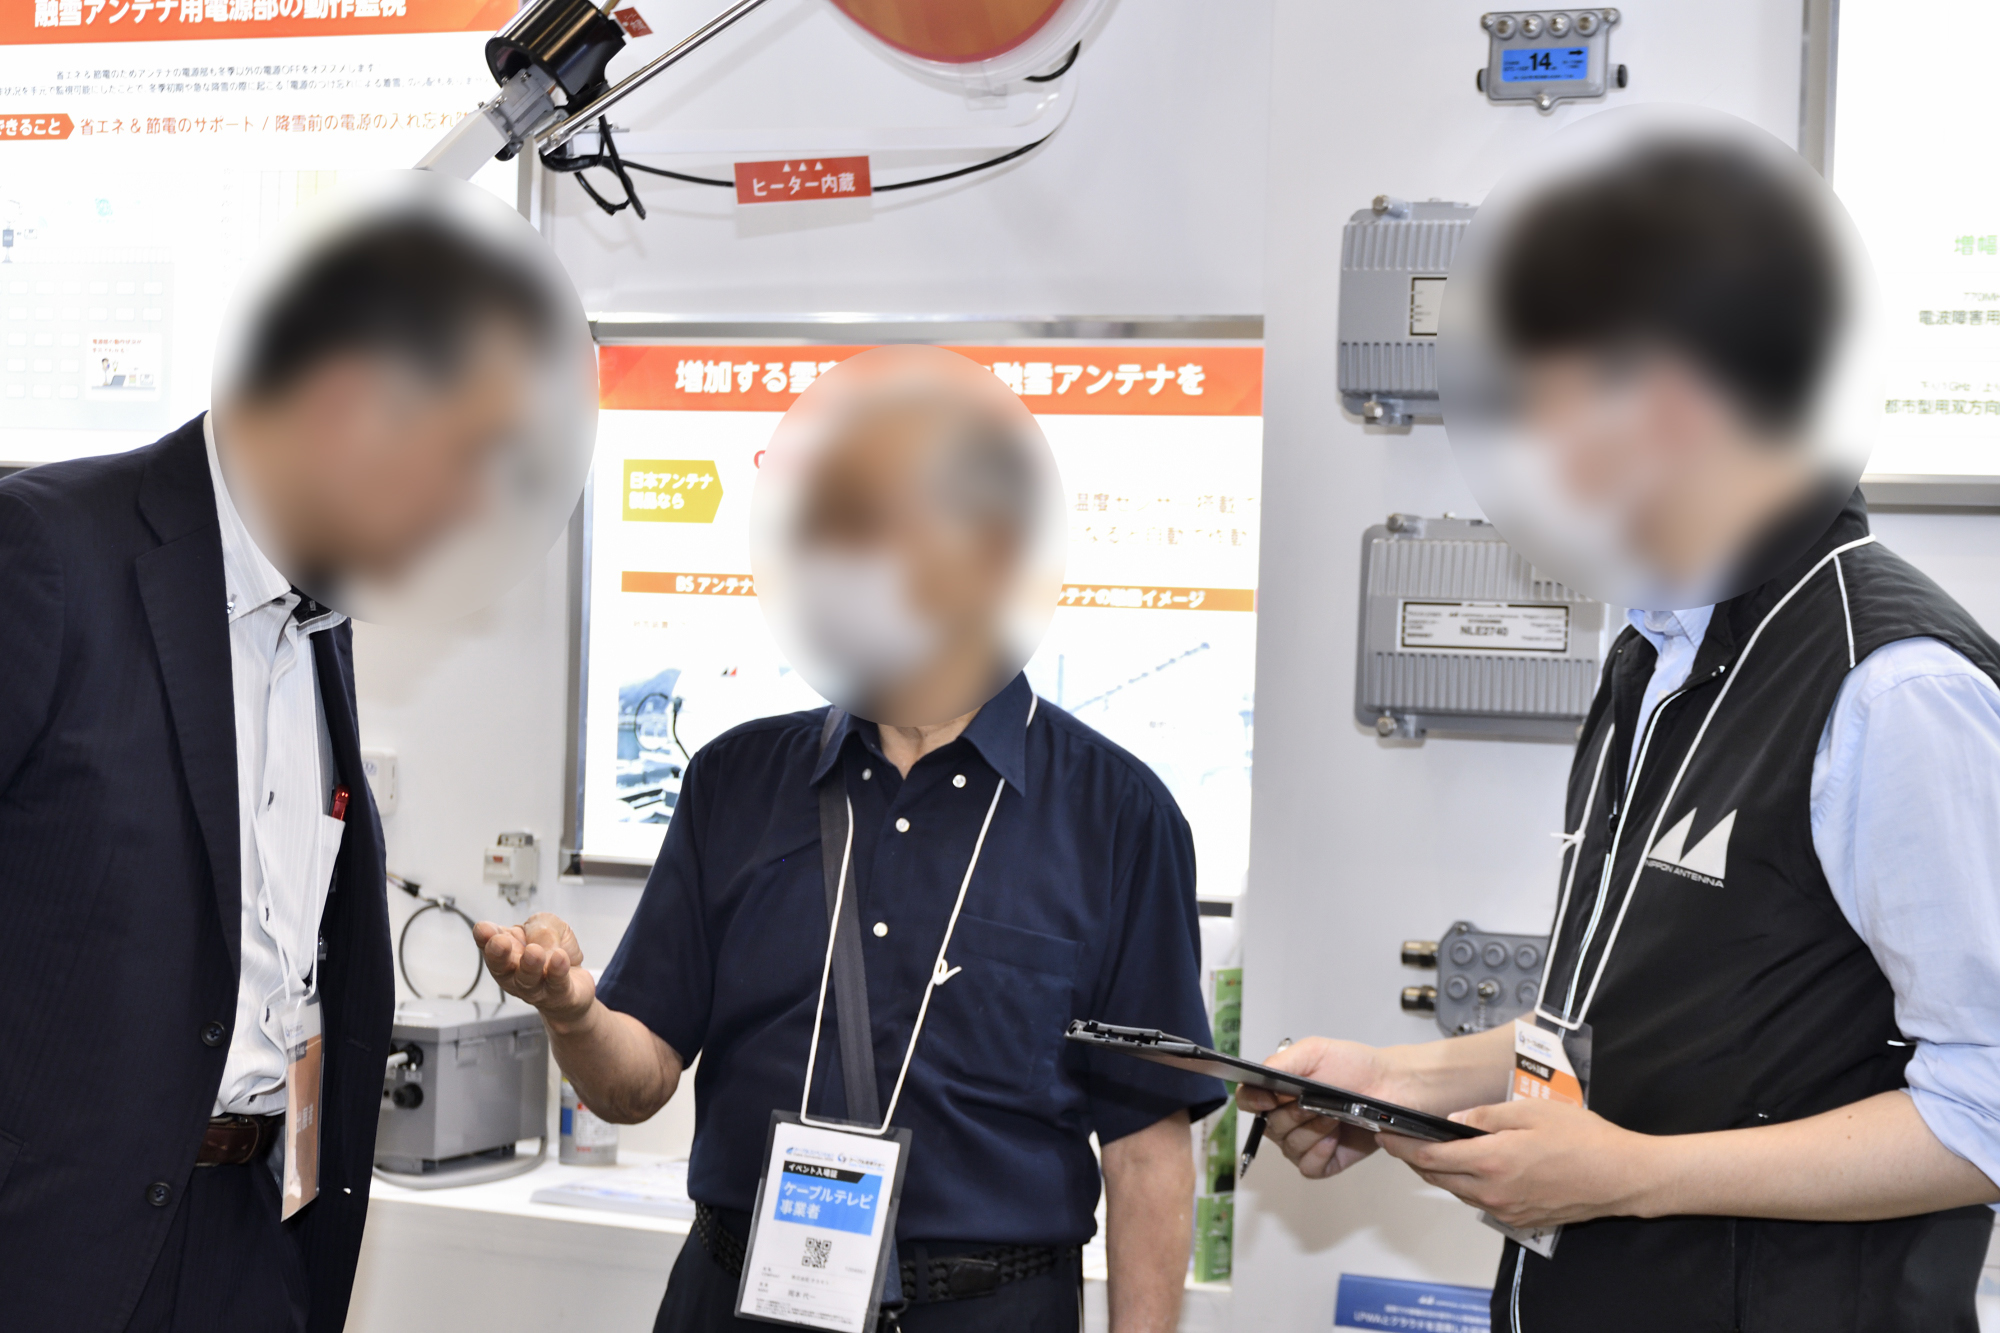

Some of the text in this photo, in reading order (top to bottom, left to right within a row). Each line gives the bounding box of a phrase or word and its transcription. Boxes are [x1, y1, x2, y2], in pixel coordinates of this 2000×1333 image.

[1529, 52, 1552, 71] 14
[80, 118, 125, 136] 省エネ
[130, 118, 141, 134] &
[146, 115, 253, 135] 節電のサポート
[752, 172, 856, 197] ヒーター内蔵
[1919, 310, 2000, 325] 電波障害用
[675, 359, 1206, 396] 増加する雪 融雪アンテナを
[630, 471, 714, 490] 日本アンテナ
[675, 575, 757, 595] BSアンテナ
[1644, 860, 1725, 888] NIPPON ANTENNA
[788, 1163, 838, 1179] イベント入場証
[784, 1181, 874, 1210] ケーブルテレビ
[780, 1199, 821, 1221] 事業者
